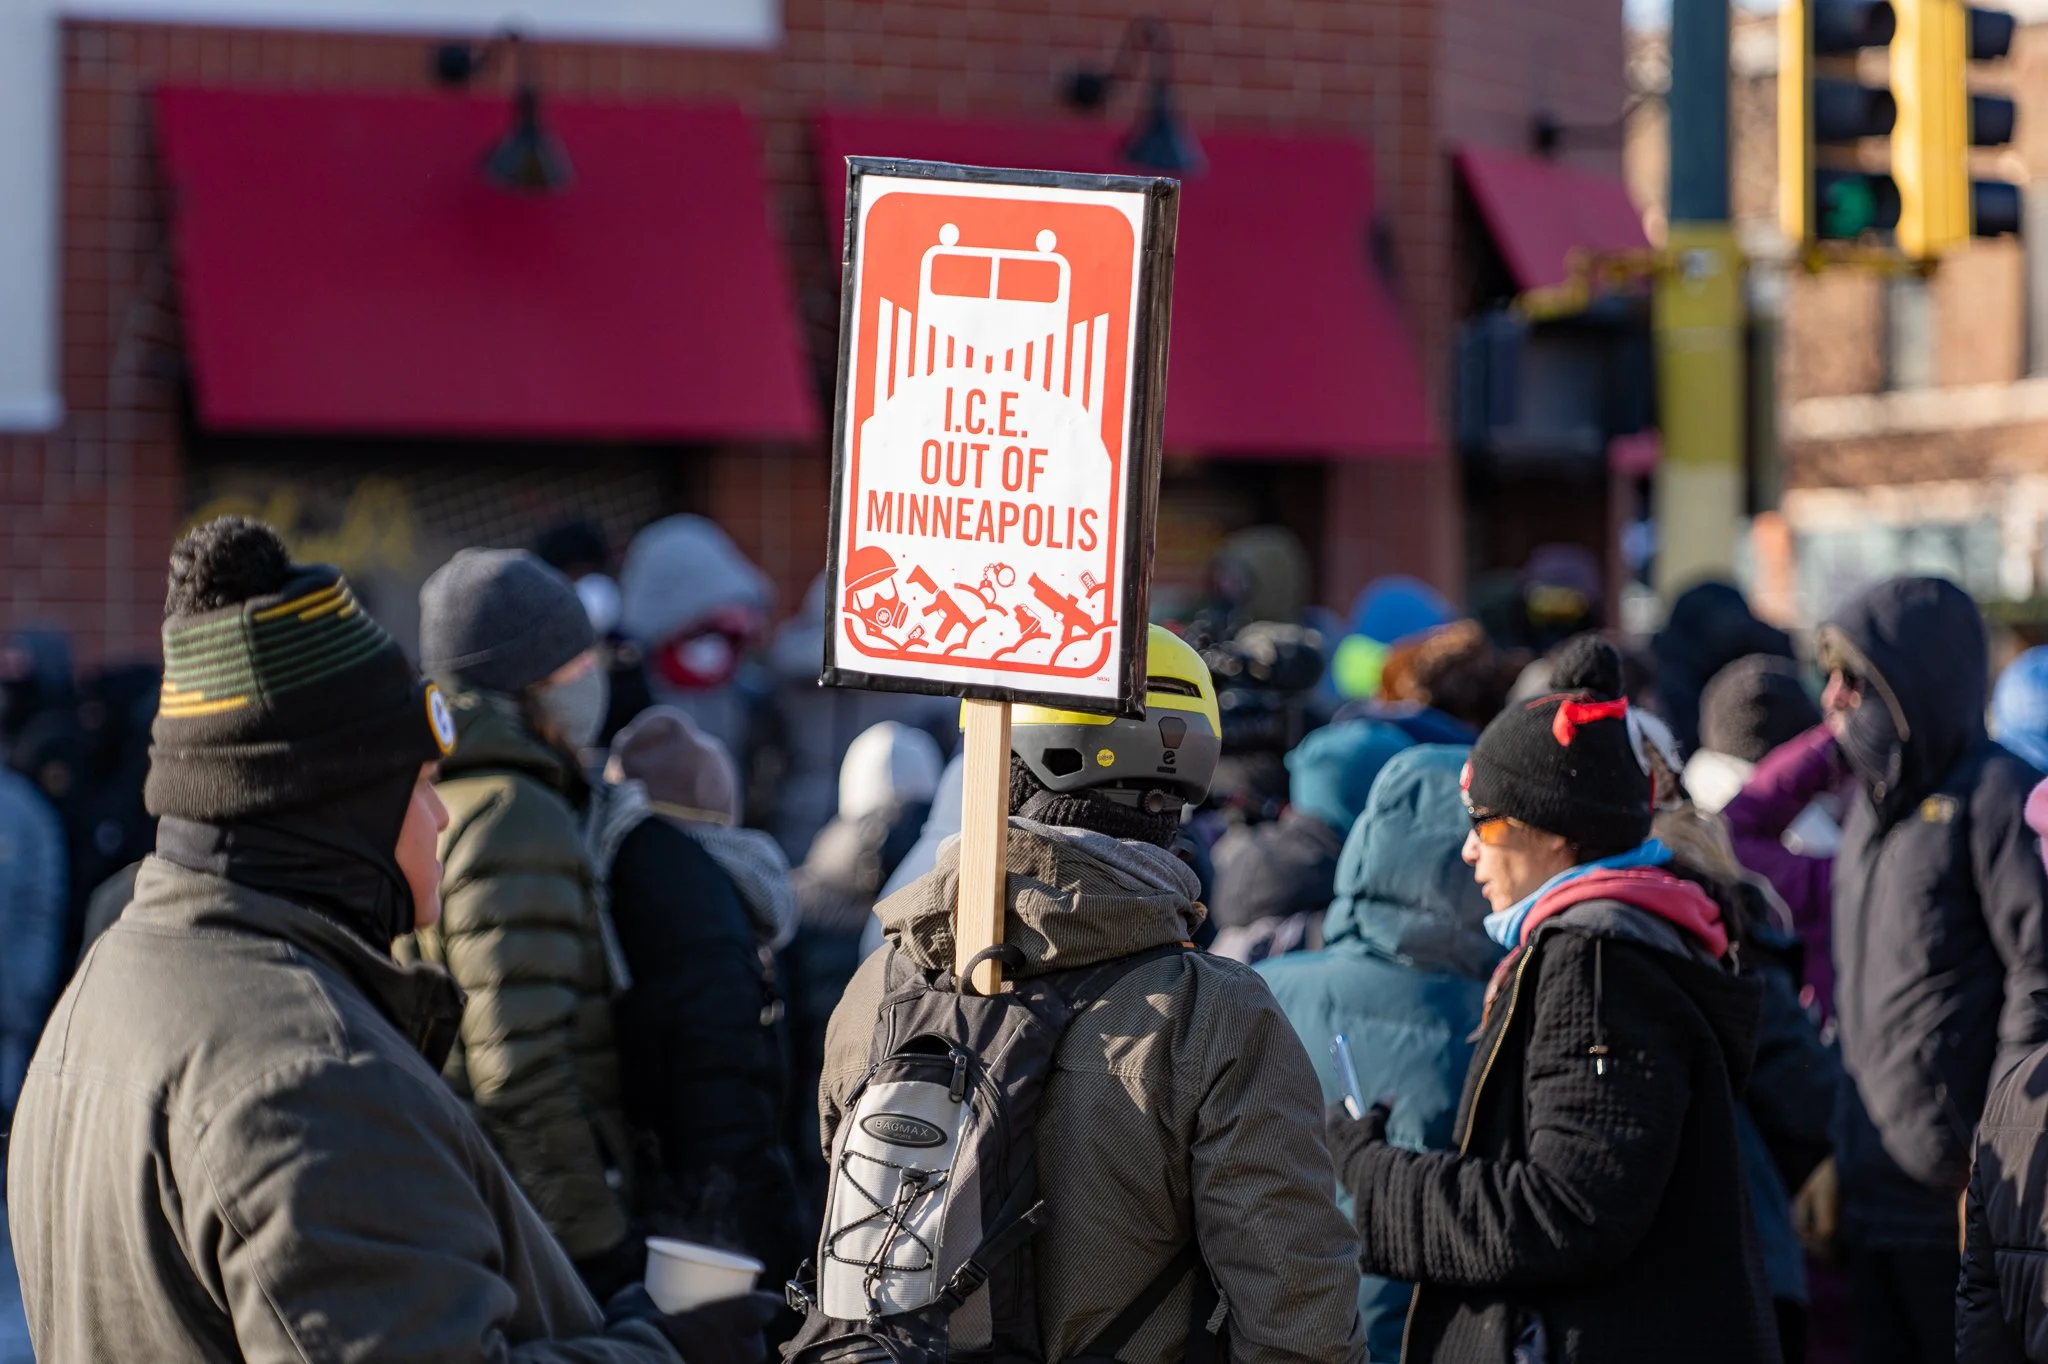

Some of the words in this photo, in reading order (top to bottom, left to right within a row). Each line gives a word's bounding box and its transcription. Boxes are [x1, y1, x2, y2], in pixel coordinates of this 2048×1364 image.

[944, 387, 1028, 438] I.C.E.
[920, 439, 990, 489] OUT
[1001, 445, 1049, 493] OF
[866, 489, 1099, 552] MINNEAPOLIS
[875, 1120, 929, 1137] BAGMAX
